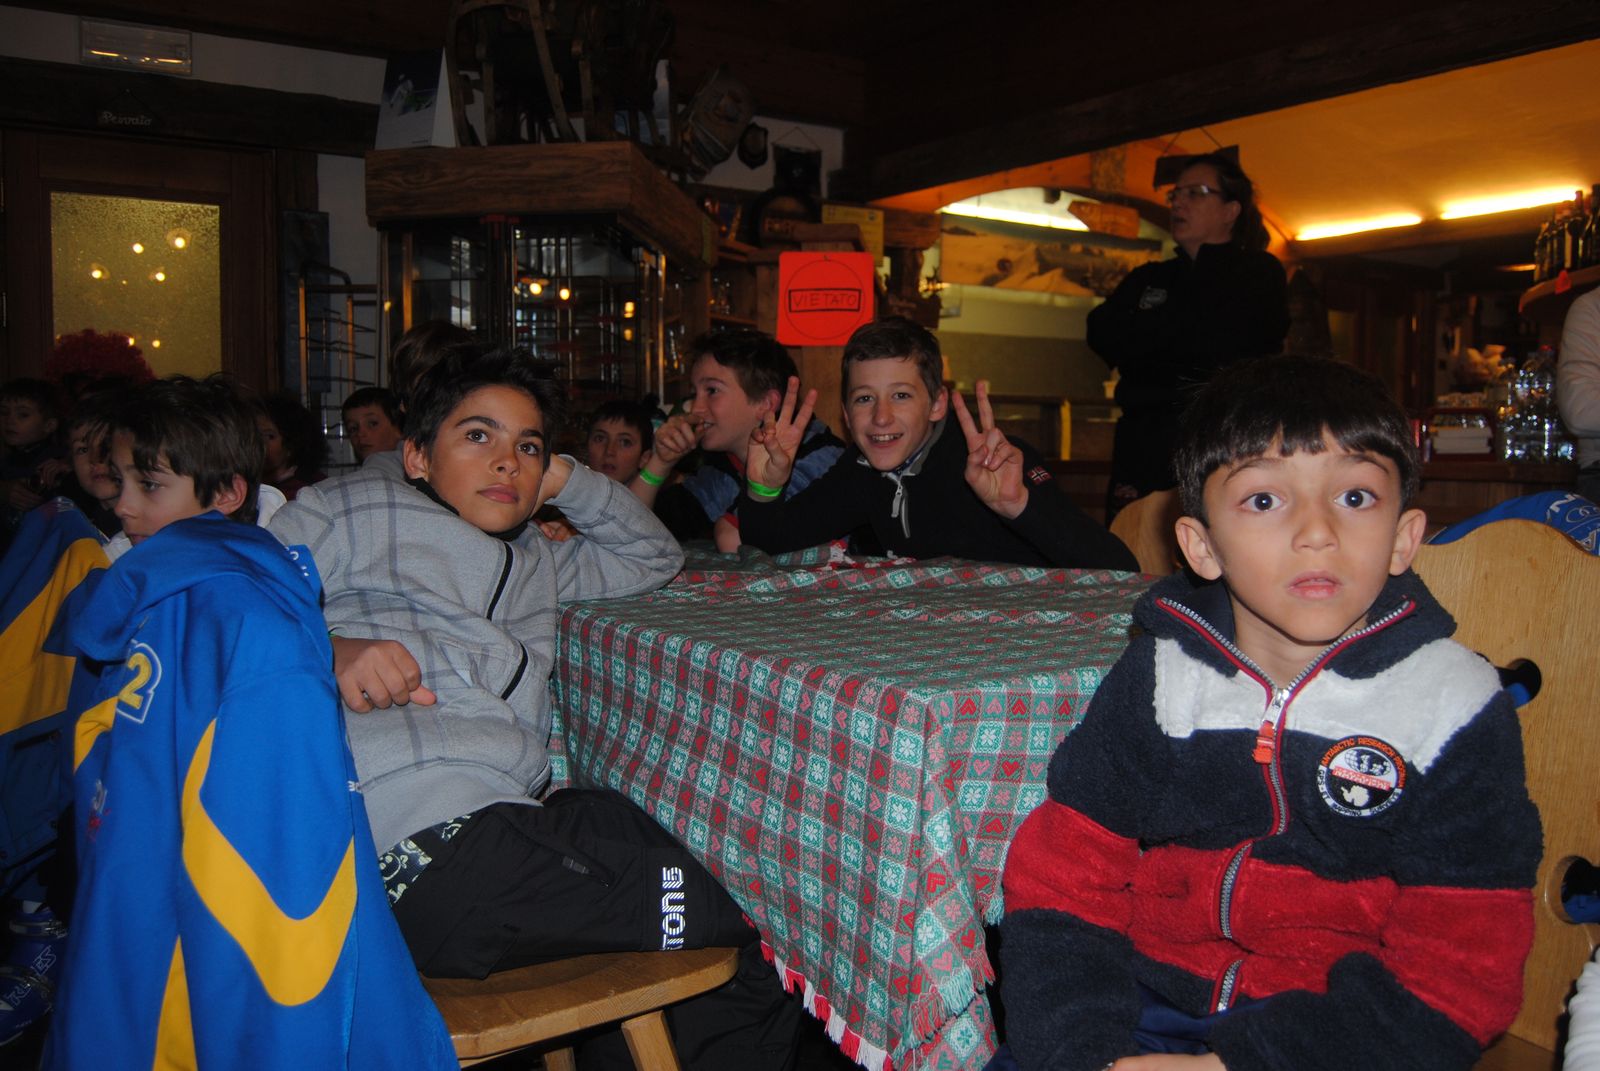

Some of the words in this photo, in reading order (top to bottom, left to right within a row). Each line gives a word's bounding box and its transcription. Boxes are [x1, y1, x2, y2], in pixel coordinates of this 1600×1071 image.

[793, 293, 857, 308] VIETATO
[1358, 737, 1395, 757] RESEARCH
[662, 866, 685, 950] TONE
